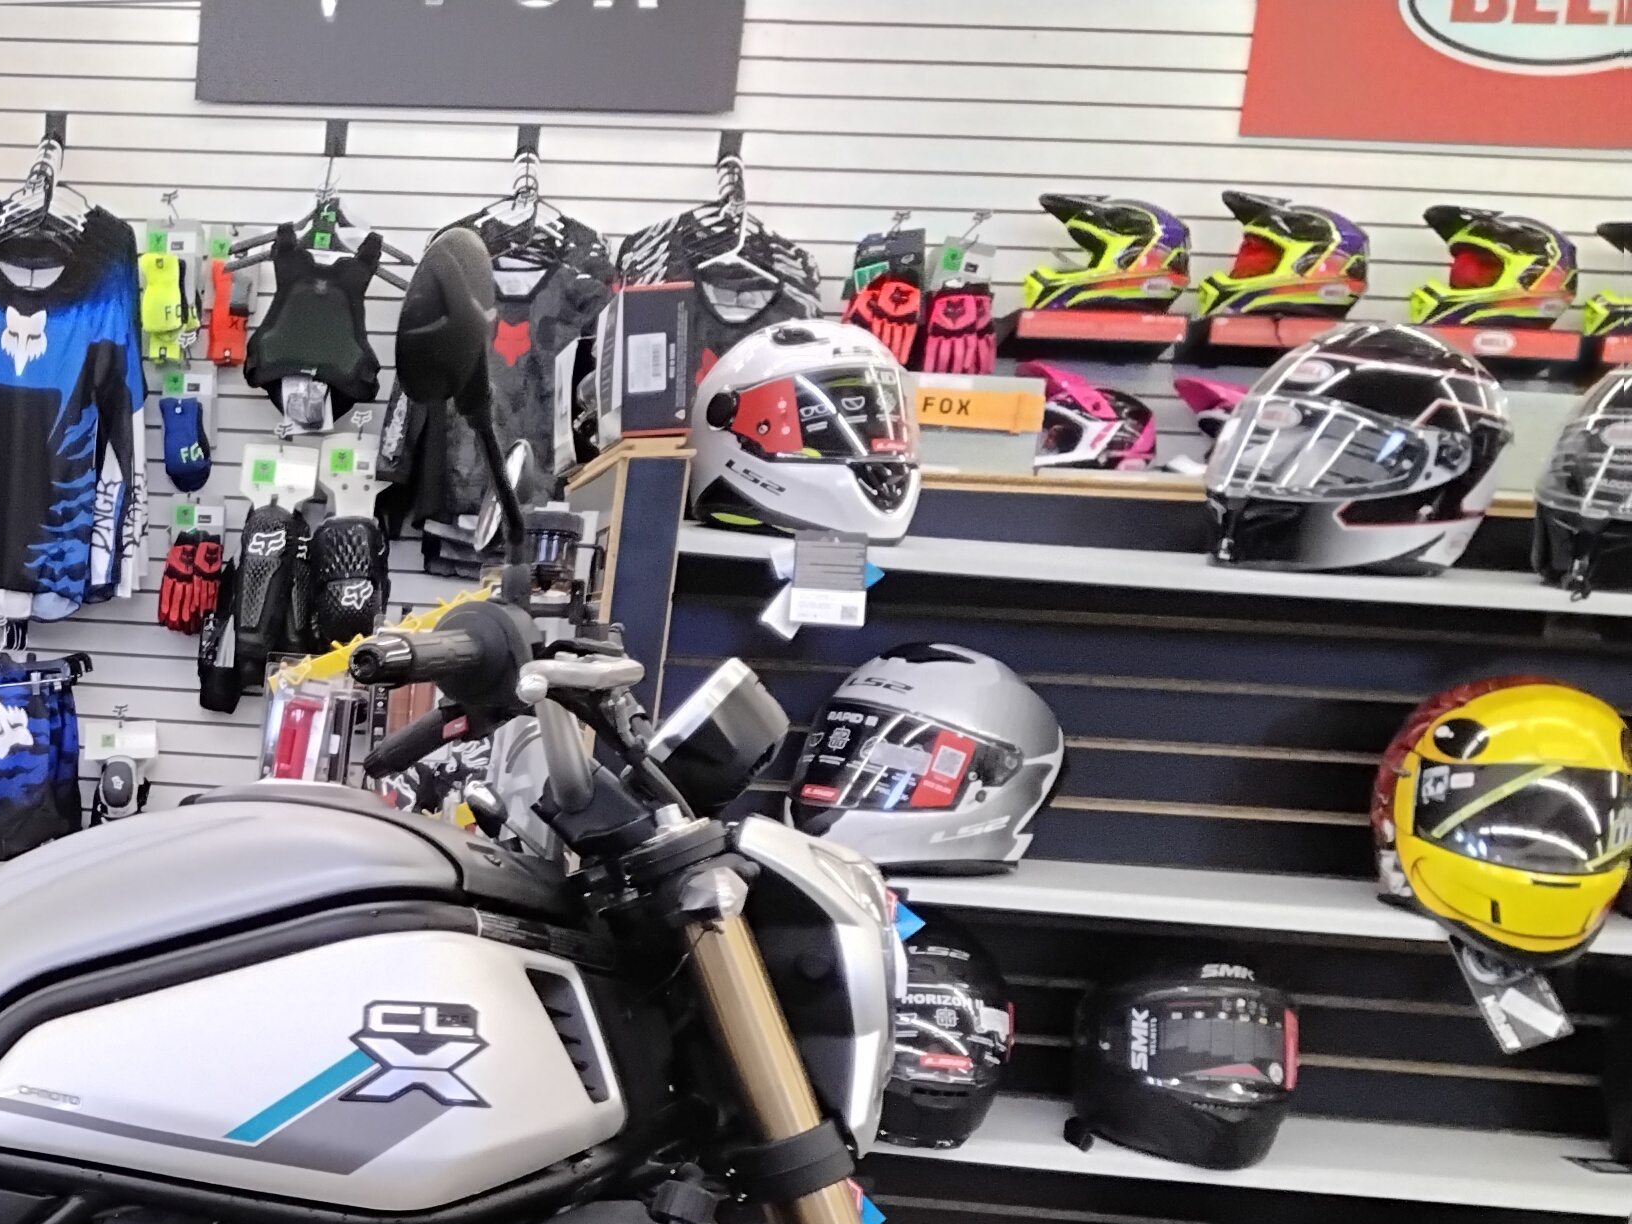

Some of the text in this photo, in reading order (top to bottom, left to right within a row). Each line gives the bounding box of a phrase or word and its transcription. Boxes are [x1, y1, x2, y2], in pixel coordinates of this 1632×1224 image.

[922, 396, 971, 416] FOX
[725, 459, 787, 496] LS2
[848, 676, 914, 695] LS2
[827, 711, 864, 724] RAPID
[929, 815, 1011, 844] LS2
[1130, 1007, 1150, 1072] SMK
